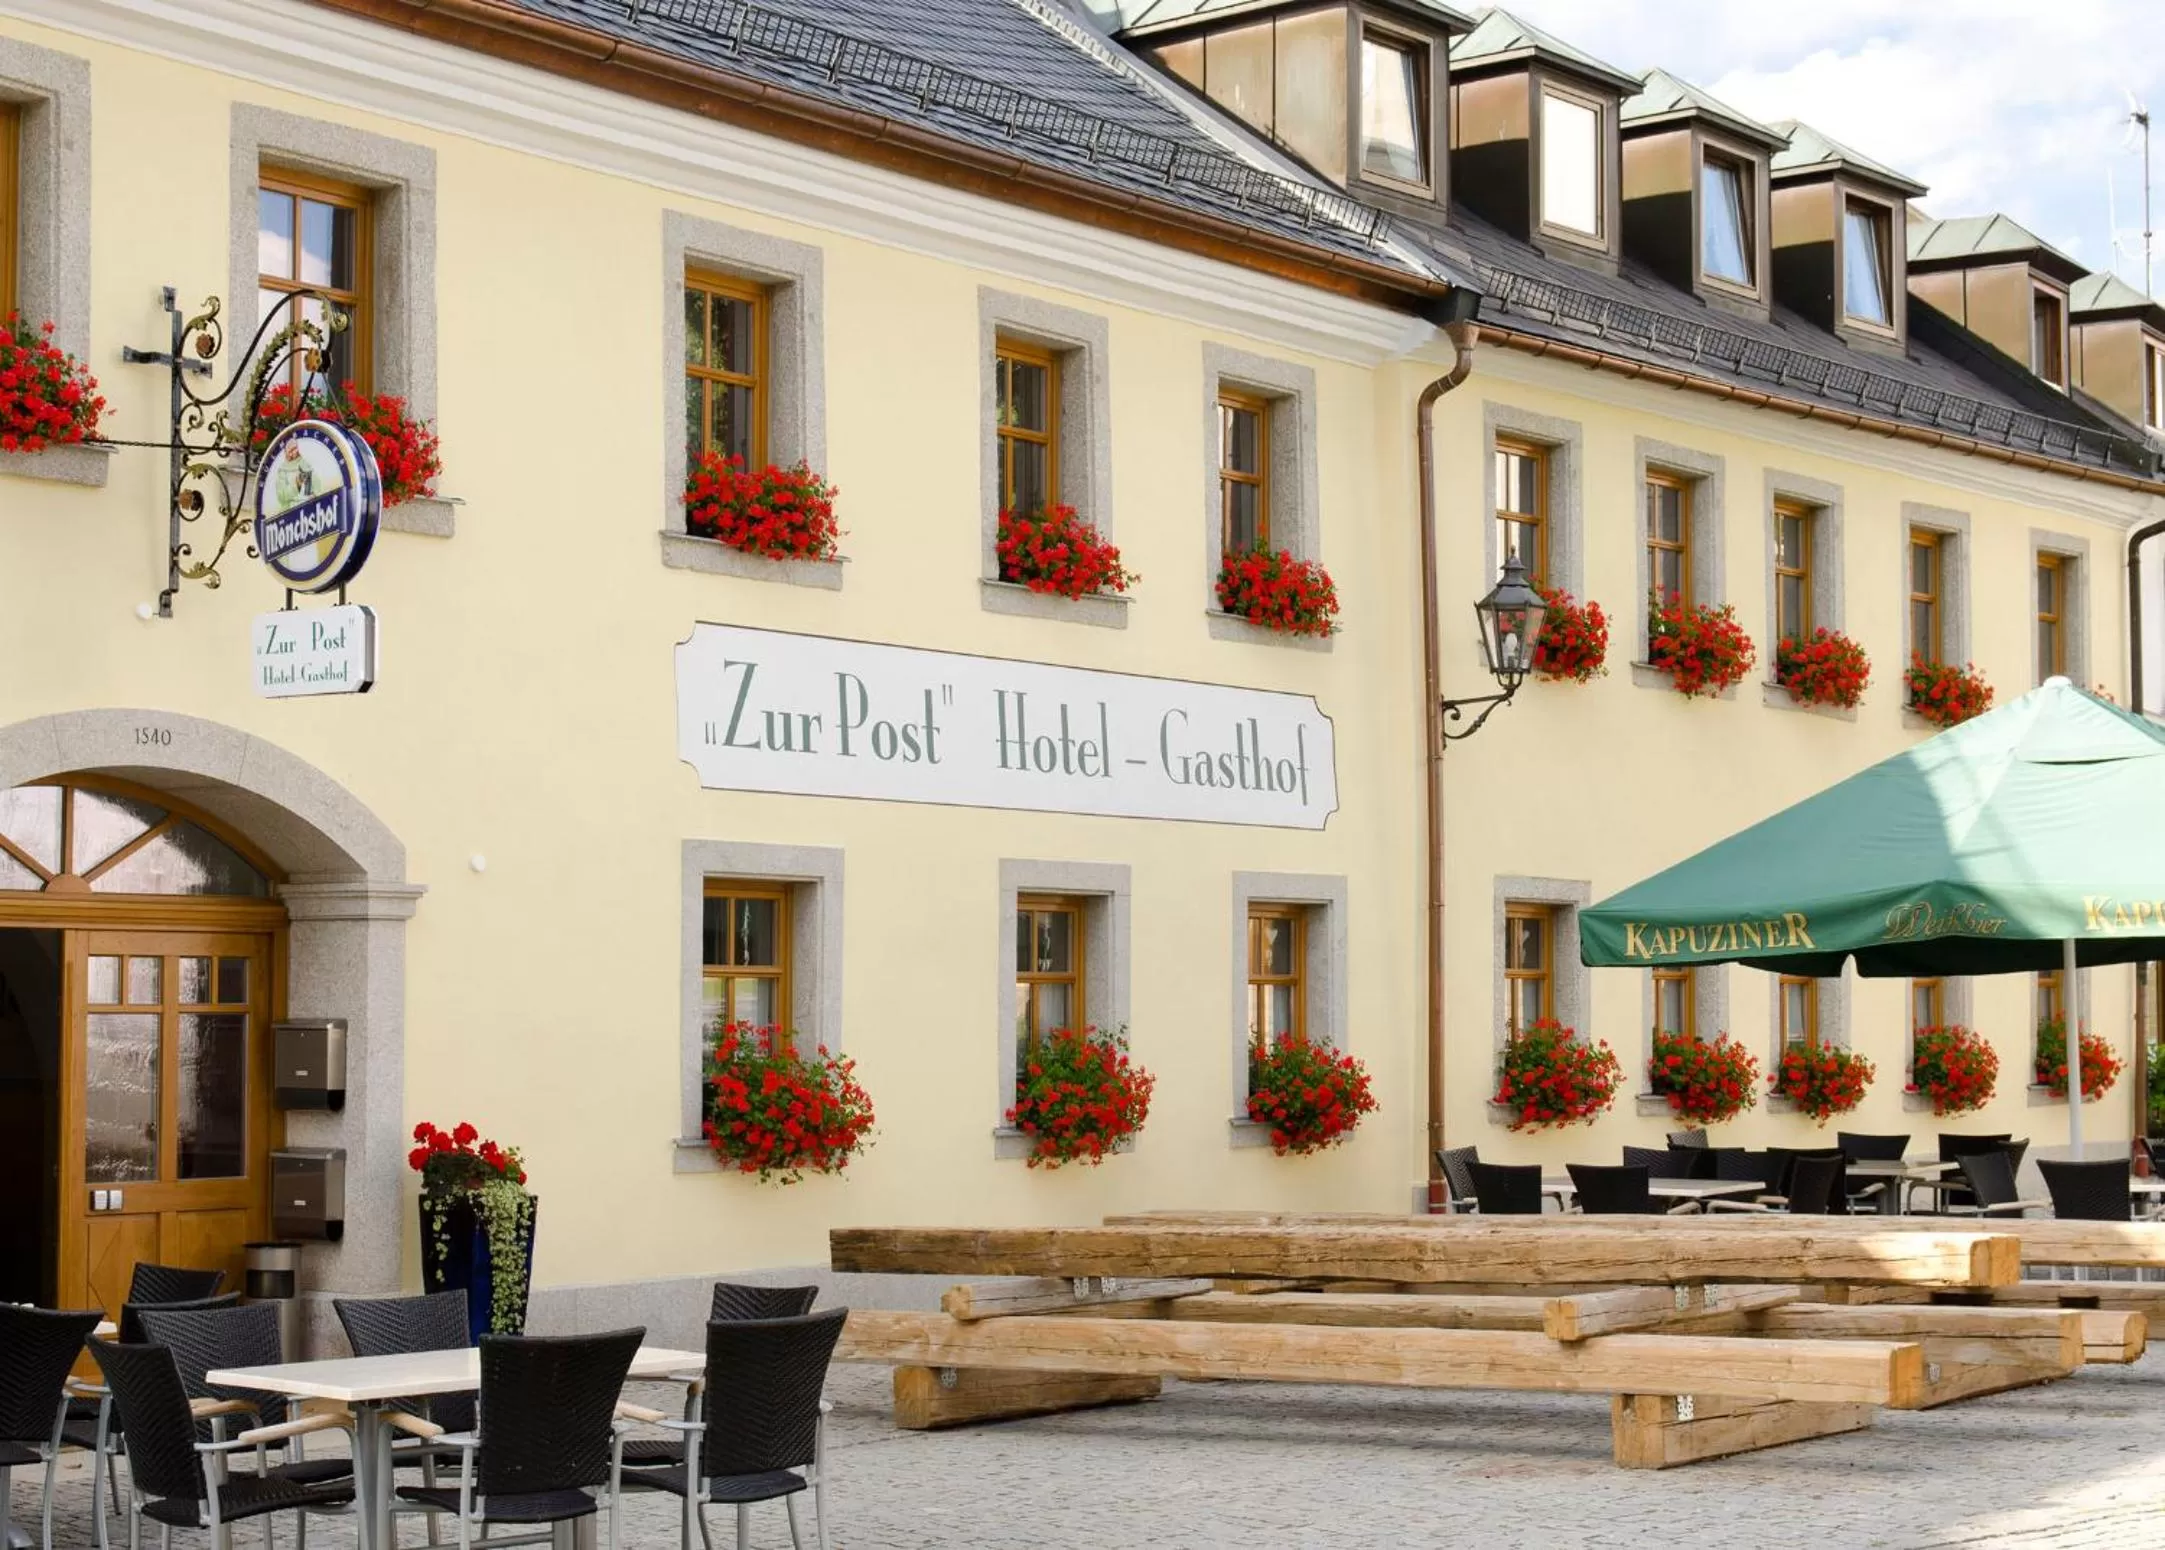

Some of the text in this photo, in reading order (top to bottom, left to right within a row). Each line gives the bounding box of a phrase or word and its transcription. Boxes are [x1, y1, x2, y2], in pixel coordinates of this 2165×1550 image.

[266, 494, 338, 556] Mönchshof
[135, 727, 171, 746] 1540
[992, 689, 1112, 778] Hotel
[1159, 708, 1309, 807] Gasthof
[1624, 912, 1816, 960] KAPUZINER
